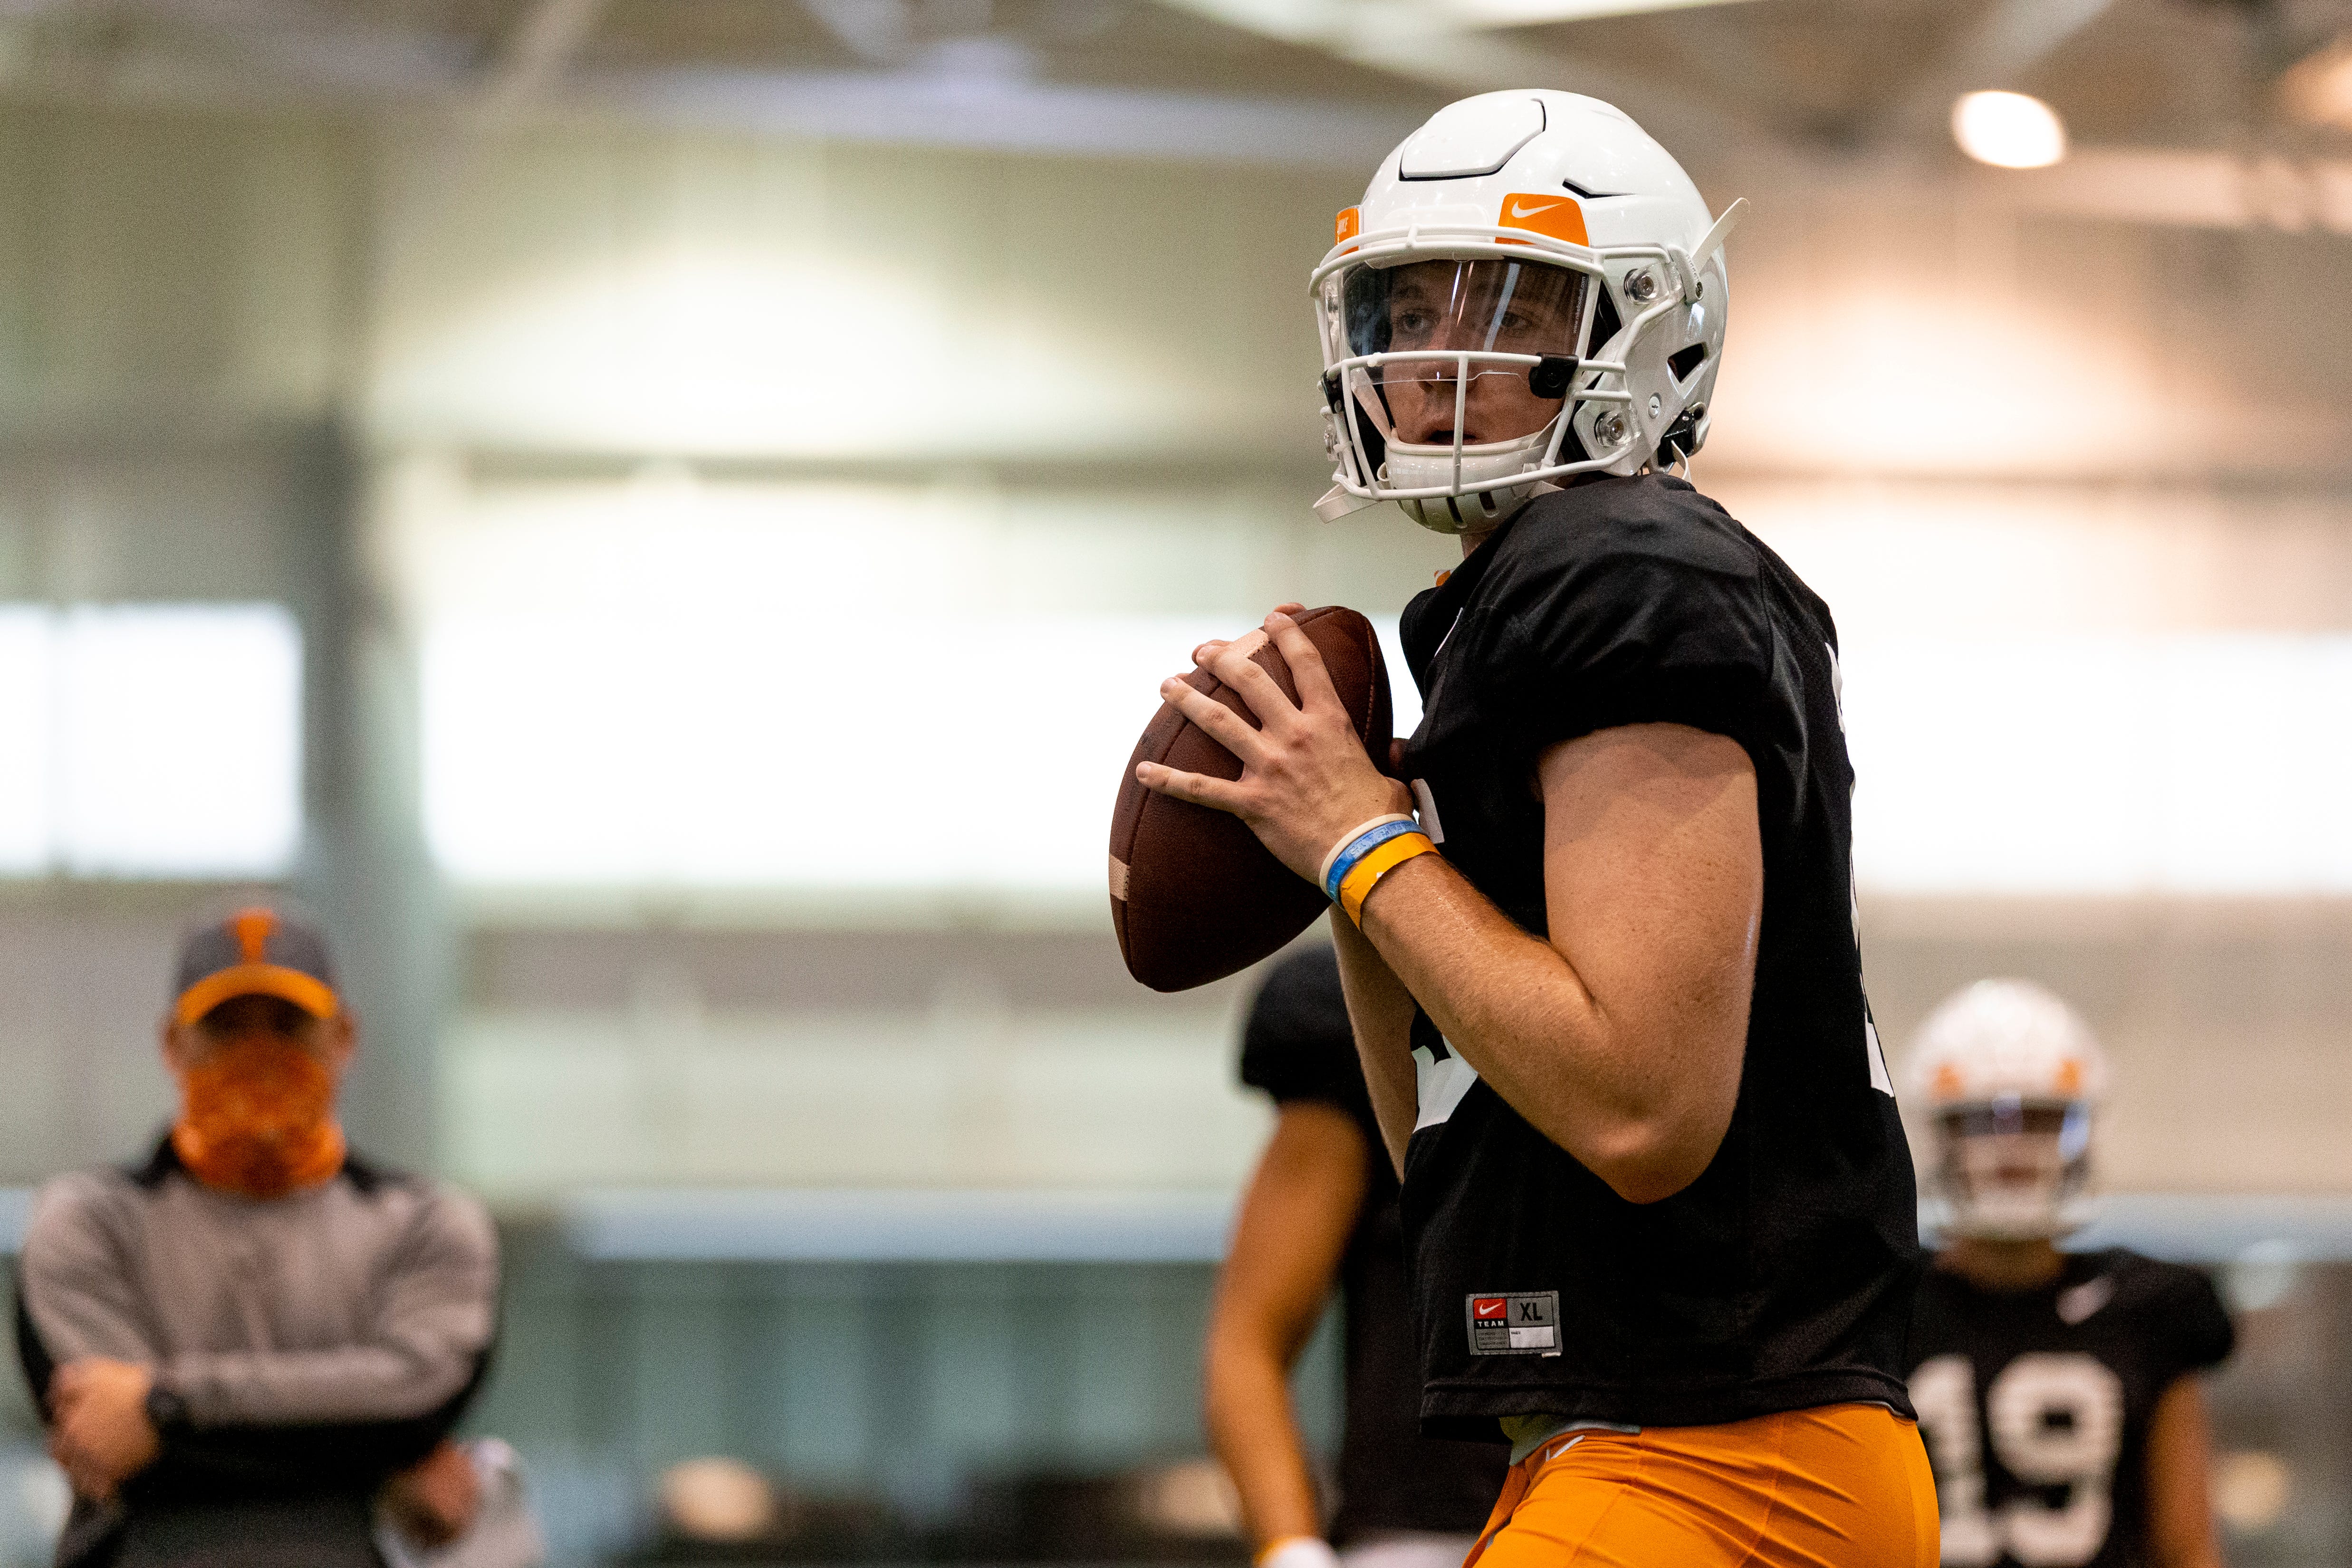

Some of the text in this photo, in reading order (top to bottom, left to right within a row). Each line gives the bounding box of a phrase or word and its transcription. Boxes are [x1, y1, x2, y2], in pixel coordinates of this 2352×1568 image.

[1573, 277, 1586, 334] www.nikefootball.com
[1520, 1302, 1543, 1321] XL
[1907, 1350, 2124, 1567] 19
